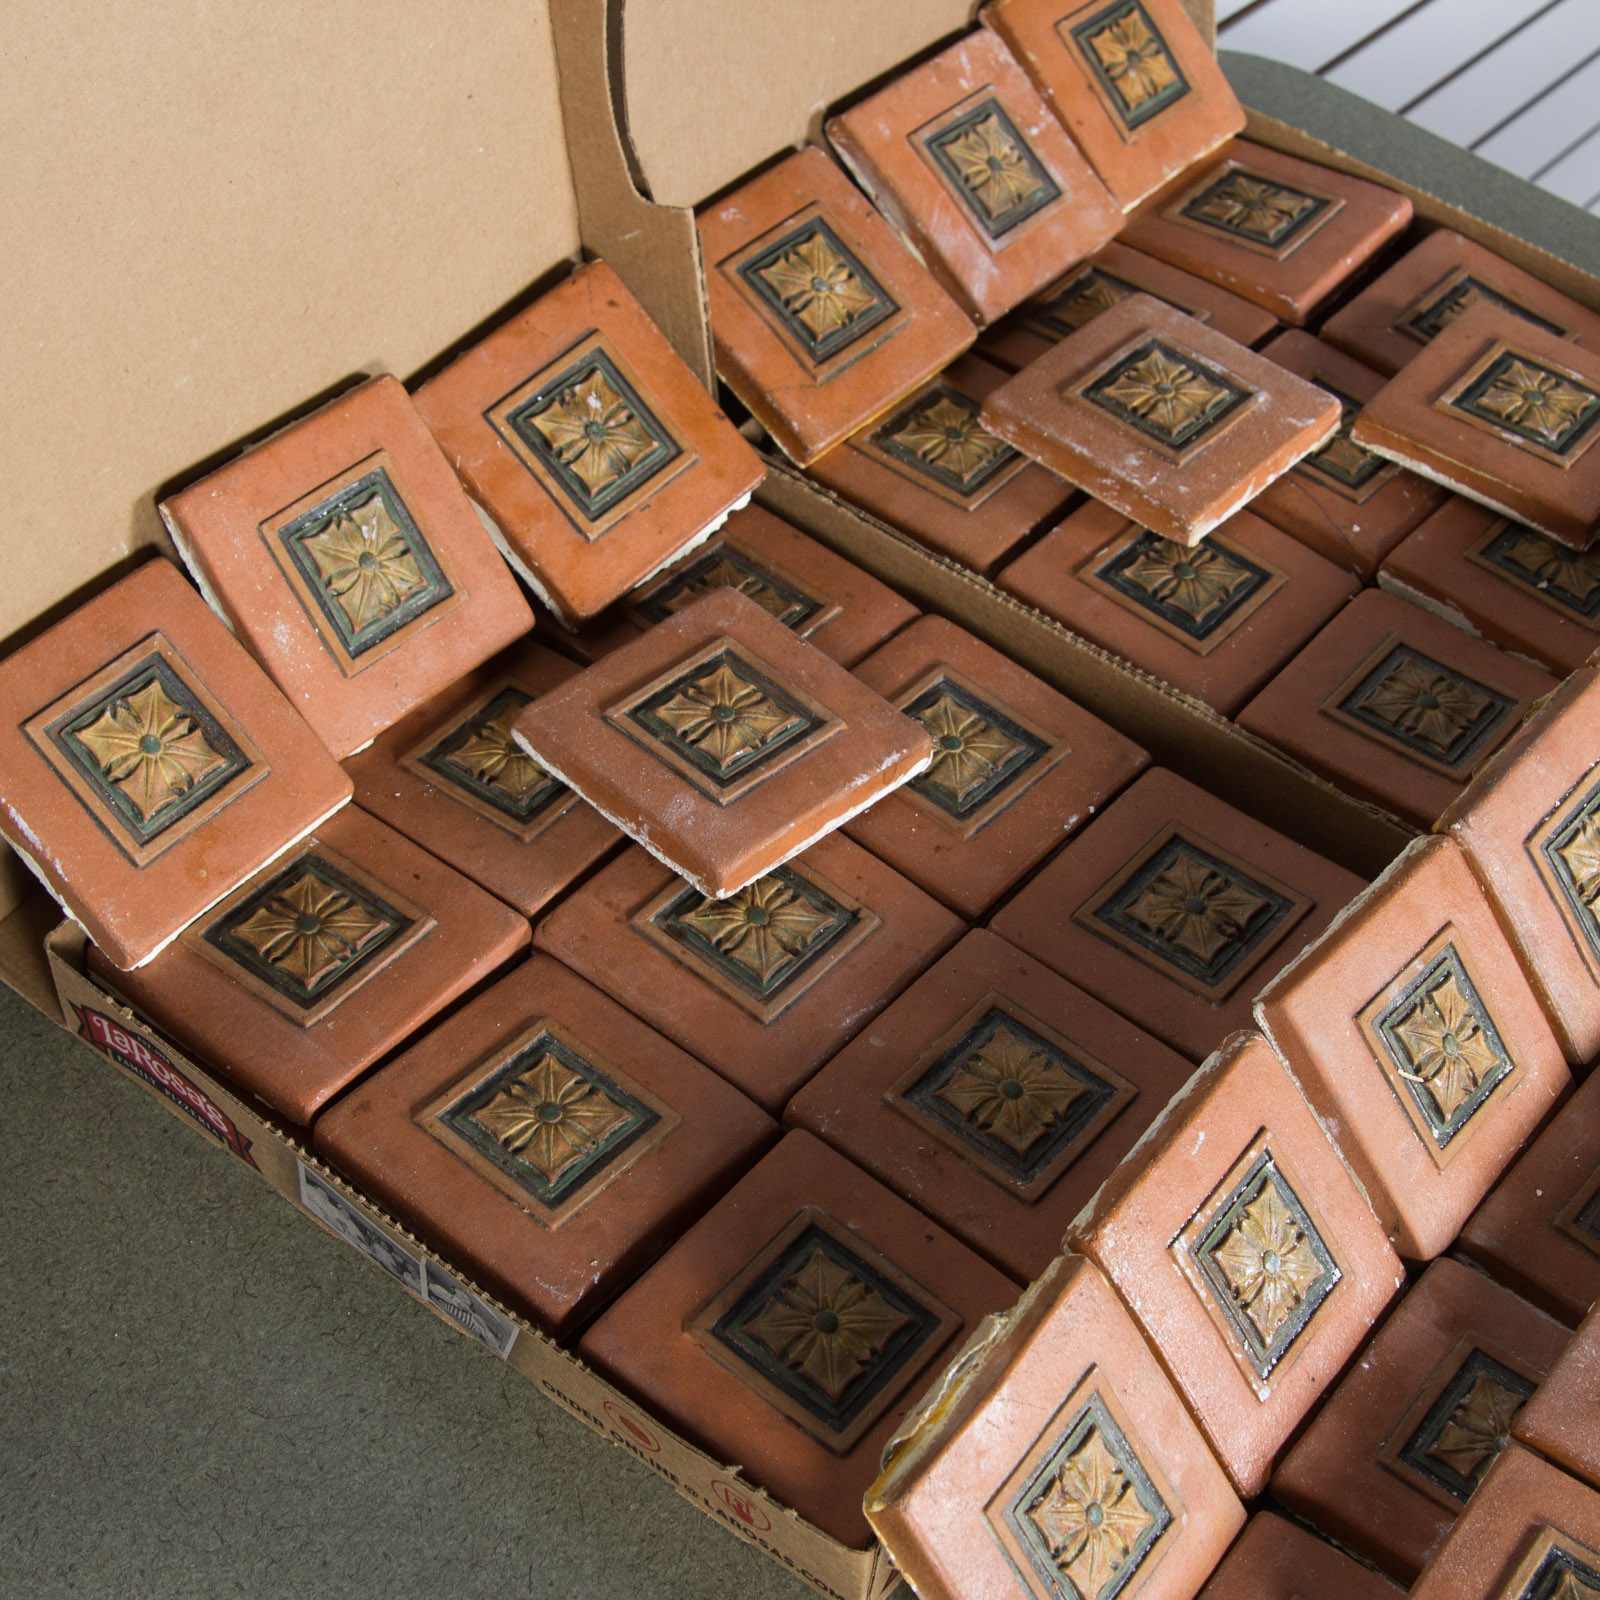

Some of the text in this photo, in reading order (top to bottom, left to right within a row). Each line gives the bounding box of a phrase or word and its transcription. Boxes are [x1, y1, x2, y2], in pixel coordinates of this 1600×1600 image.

[93, 1015, 227, 1134] LaRosa's
[117, 1055, 156, 1085] FAMILY
[164, 1088, 220, 1137] PIZZERIA
[541, 1379, 846, 1600] ORDER ONLINE @ LAROSAS.COM
